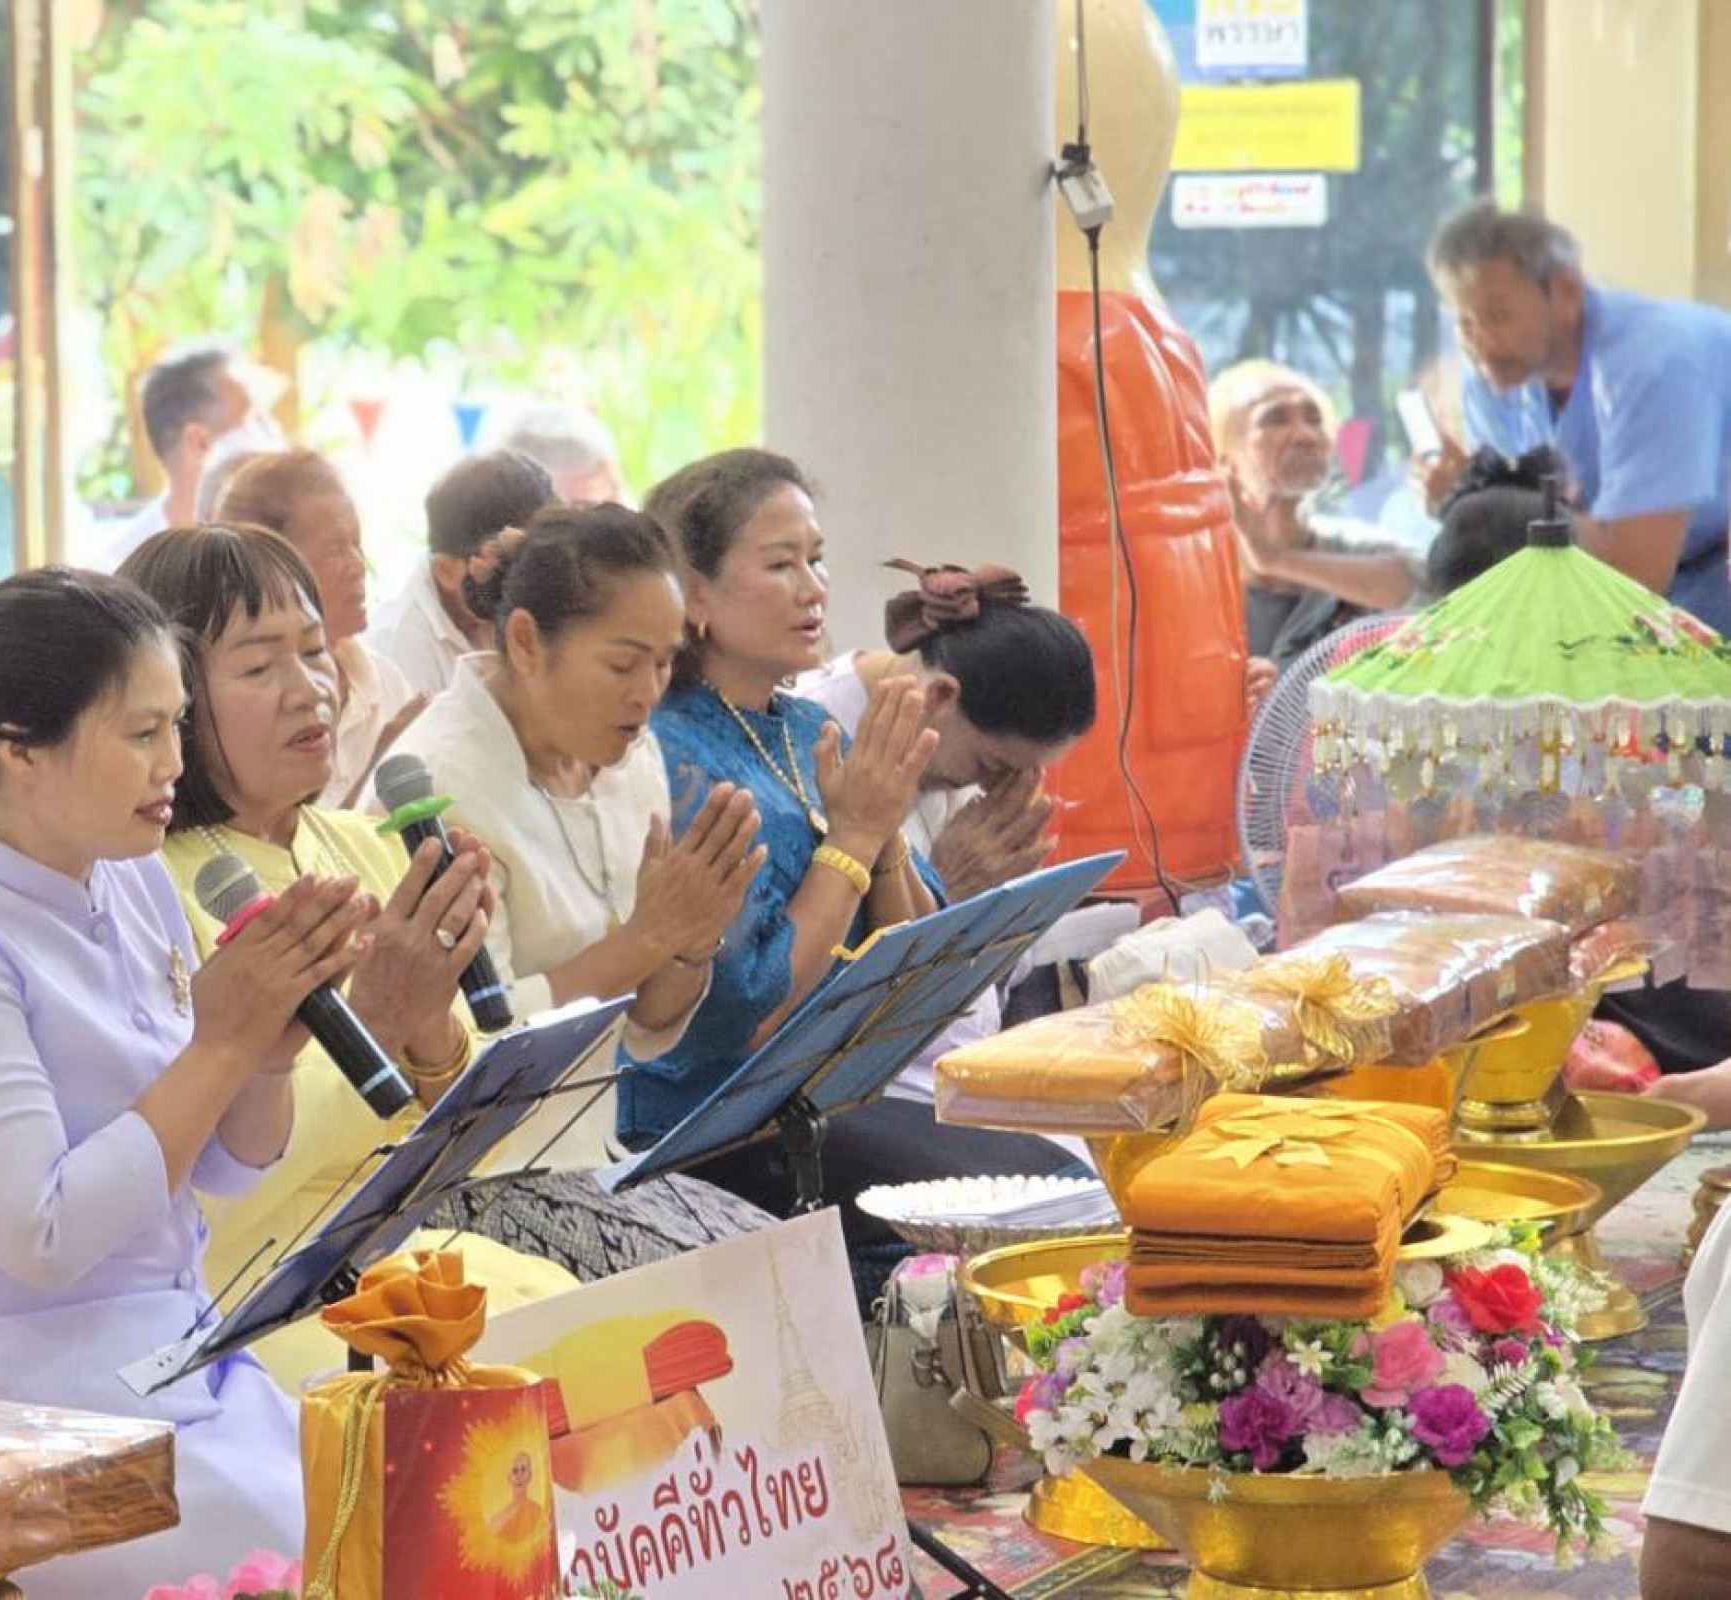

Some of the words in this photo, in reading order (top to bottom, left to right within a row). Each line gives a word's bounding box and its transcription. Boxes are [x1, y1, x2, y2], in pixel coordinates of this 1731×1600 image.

[563, 1441, 829, 1597] ามัคคีทั่วไทย
